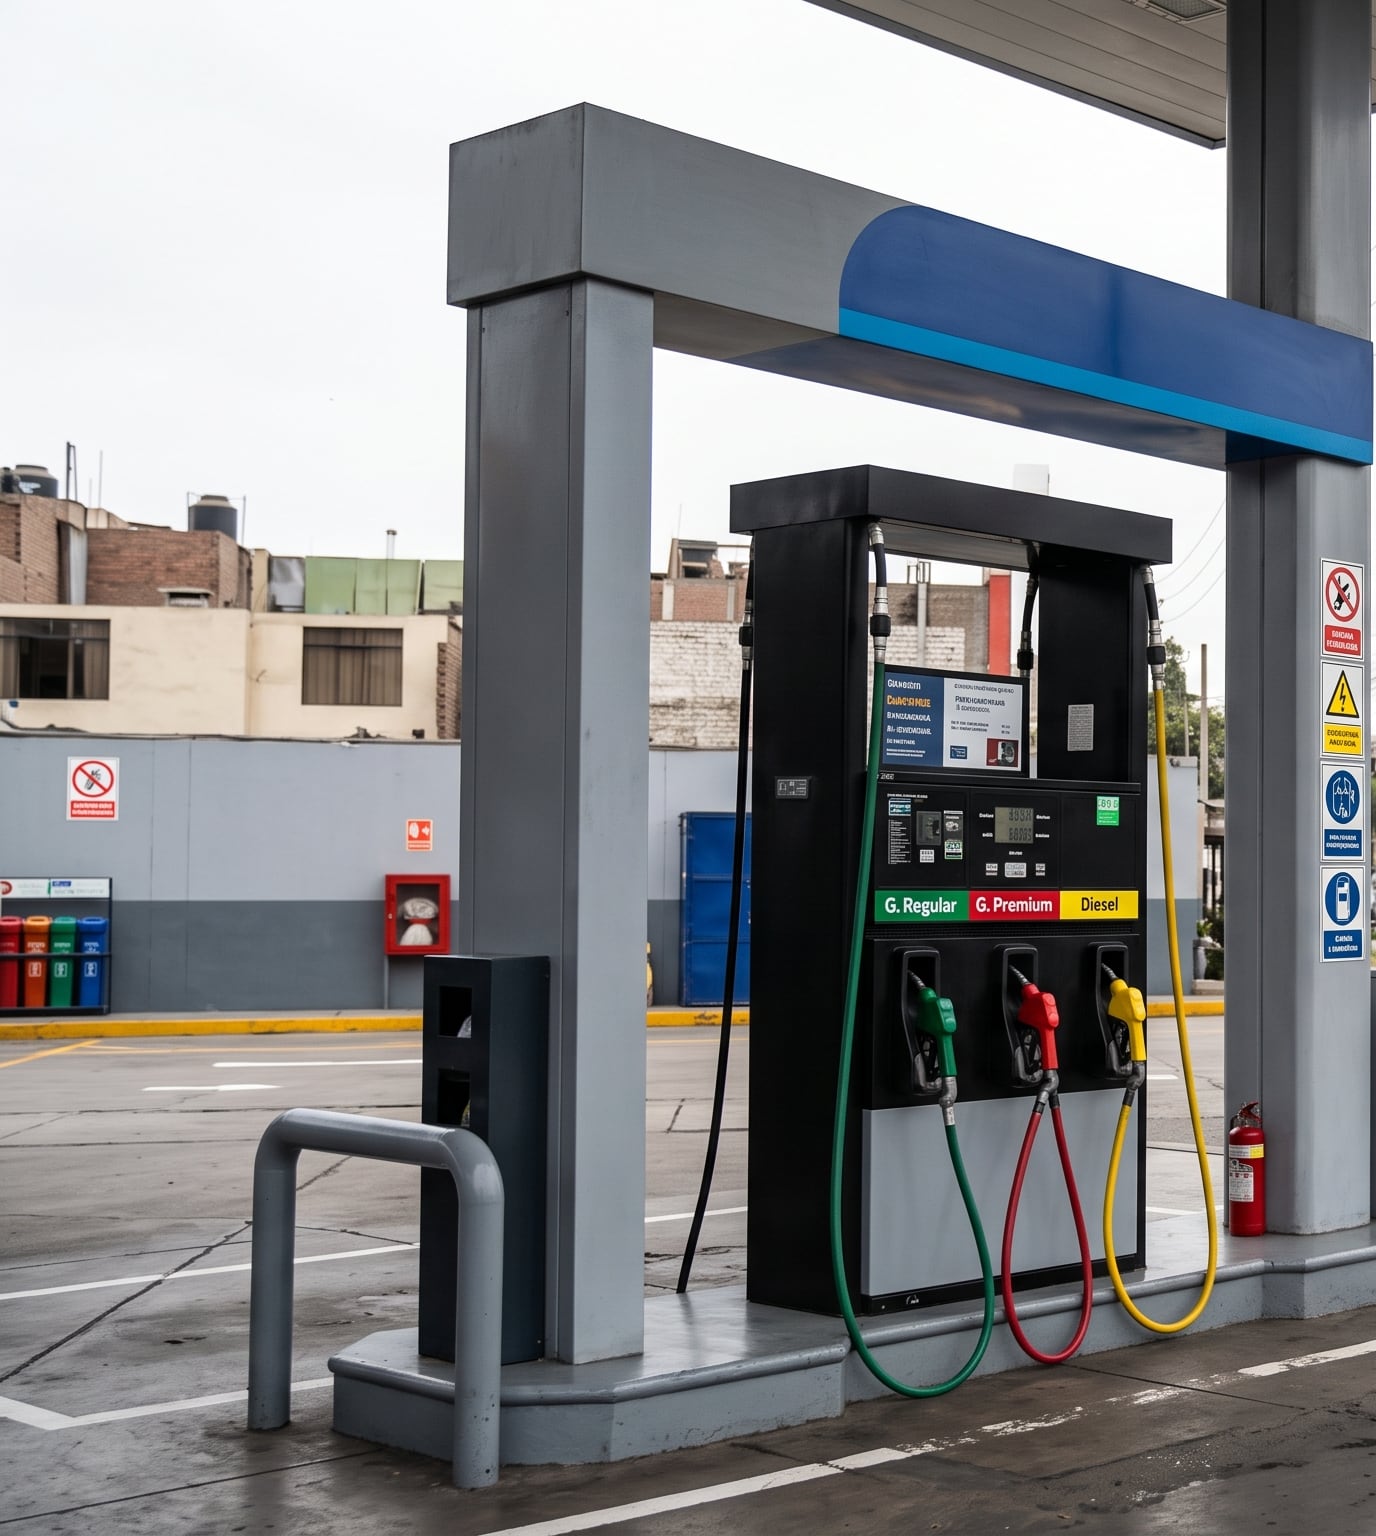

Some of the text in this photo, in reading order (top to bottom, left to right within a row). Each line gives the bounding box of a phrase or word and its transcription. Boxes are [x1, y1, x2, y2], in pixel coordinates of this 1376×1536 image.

[884, 896, 957, 917] G. Regular
[975, 896, 1053, 914] G. Premium
[1081, 896, 1119, 912] Diesel
